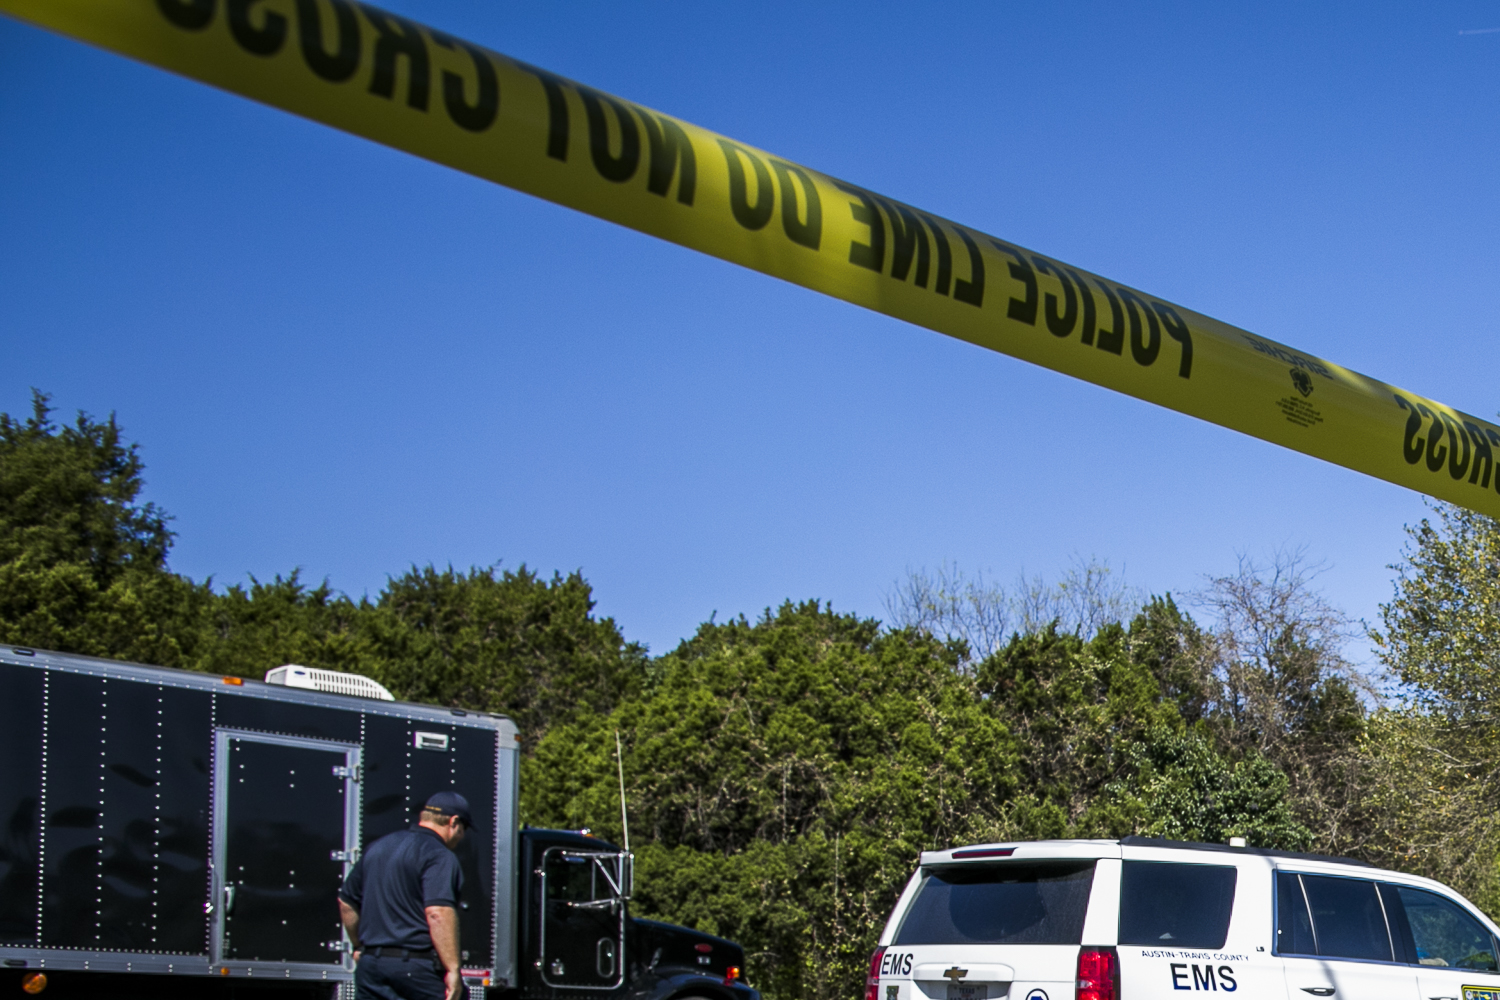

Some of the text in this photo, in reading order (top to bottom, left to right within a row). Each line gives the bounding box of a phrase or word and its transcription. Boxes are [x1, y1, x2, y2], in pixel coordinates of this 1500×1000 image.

[881, 953, 914, 976] EMS
[1142, 950, 1249, 961] AUSTIN-TRAVIS COUNTY
[1170, 963, 1237, 992] EMS
